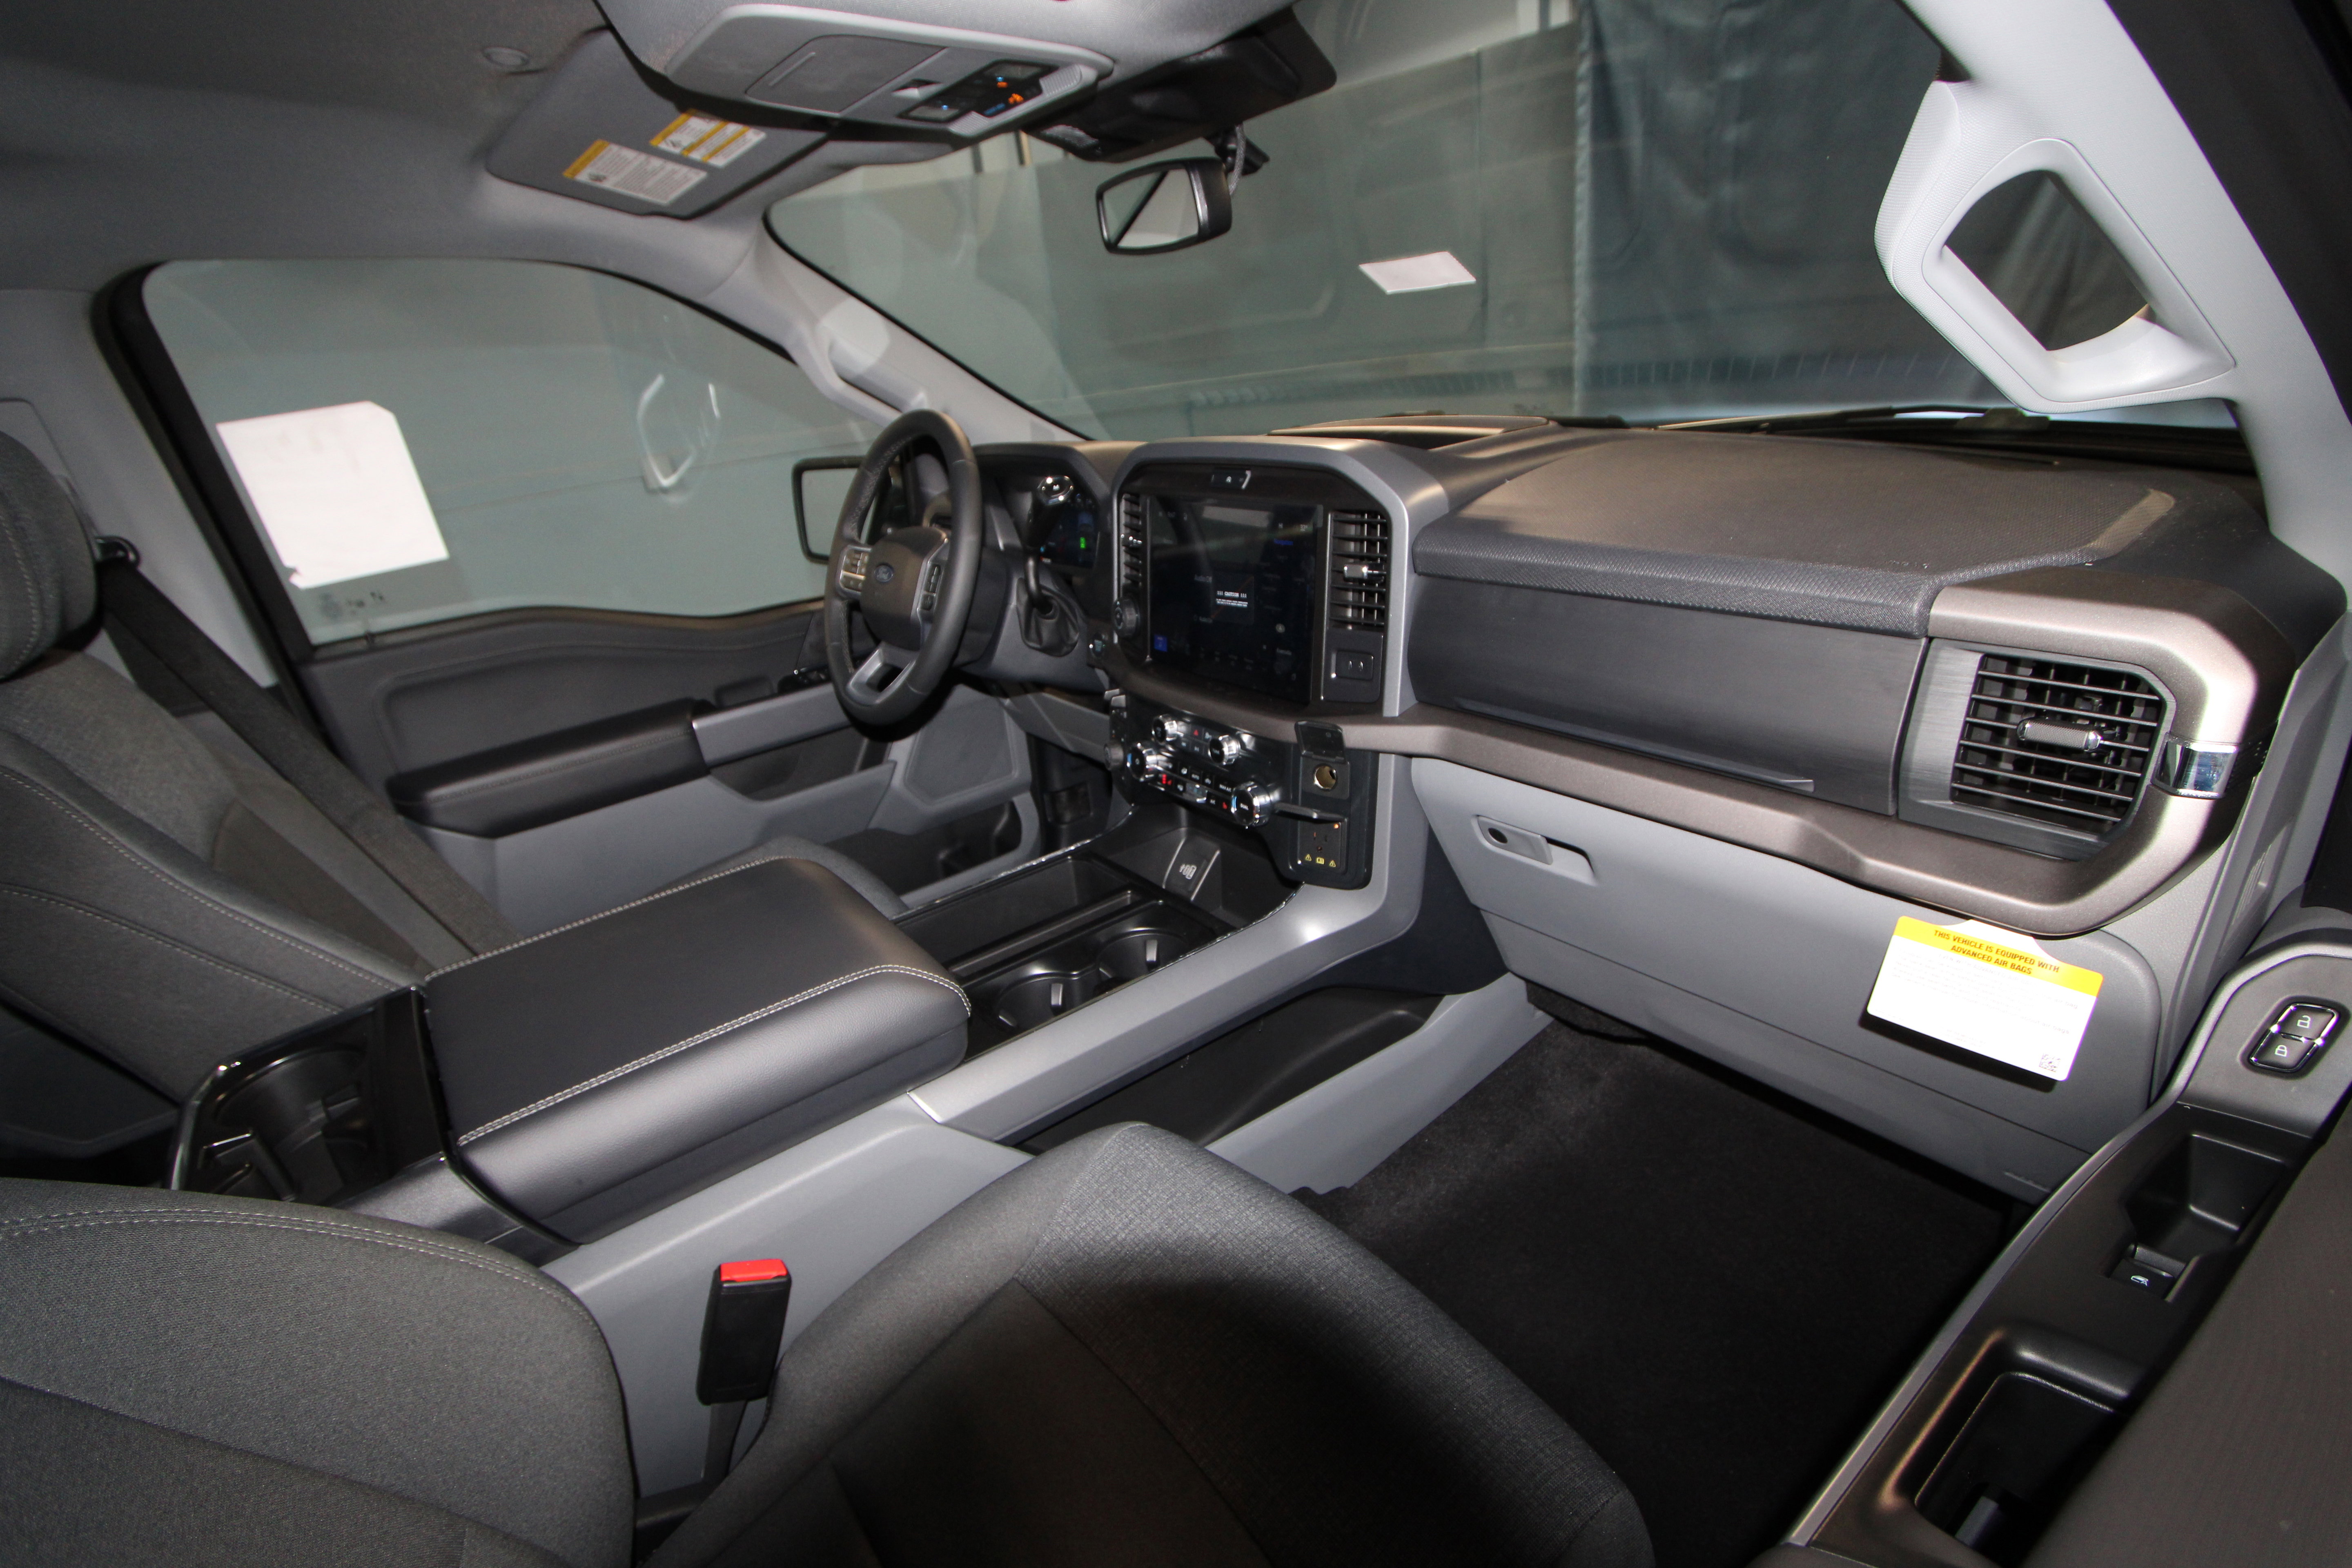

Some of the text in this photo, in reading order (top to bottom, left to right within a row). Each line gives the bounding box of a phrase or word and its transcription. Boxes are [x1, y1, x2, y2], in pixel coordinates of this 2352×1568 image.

[1934, 930, 1951, 940] THIS
[1953, 935, 1984, 950] VEHICLE
[1995, 949, 2035, 965] EQUIPPED
[2038, 960, 2060, 973] WITH
[1951, 945, 2032, 974] ADVANCED AIR BAGS
